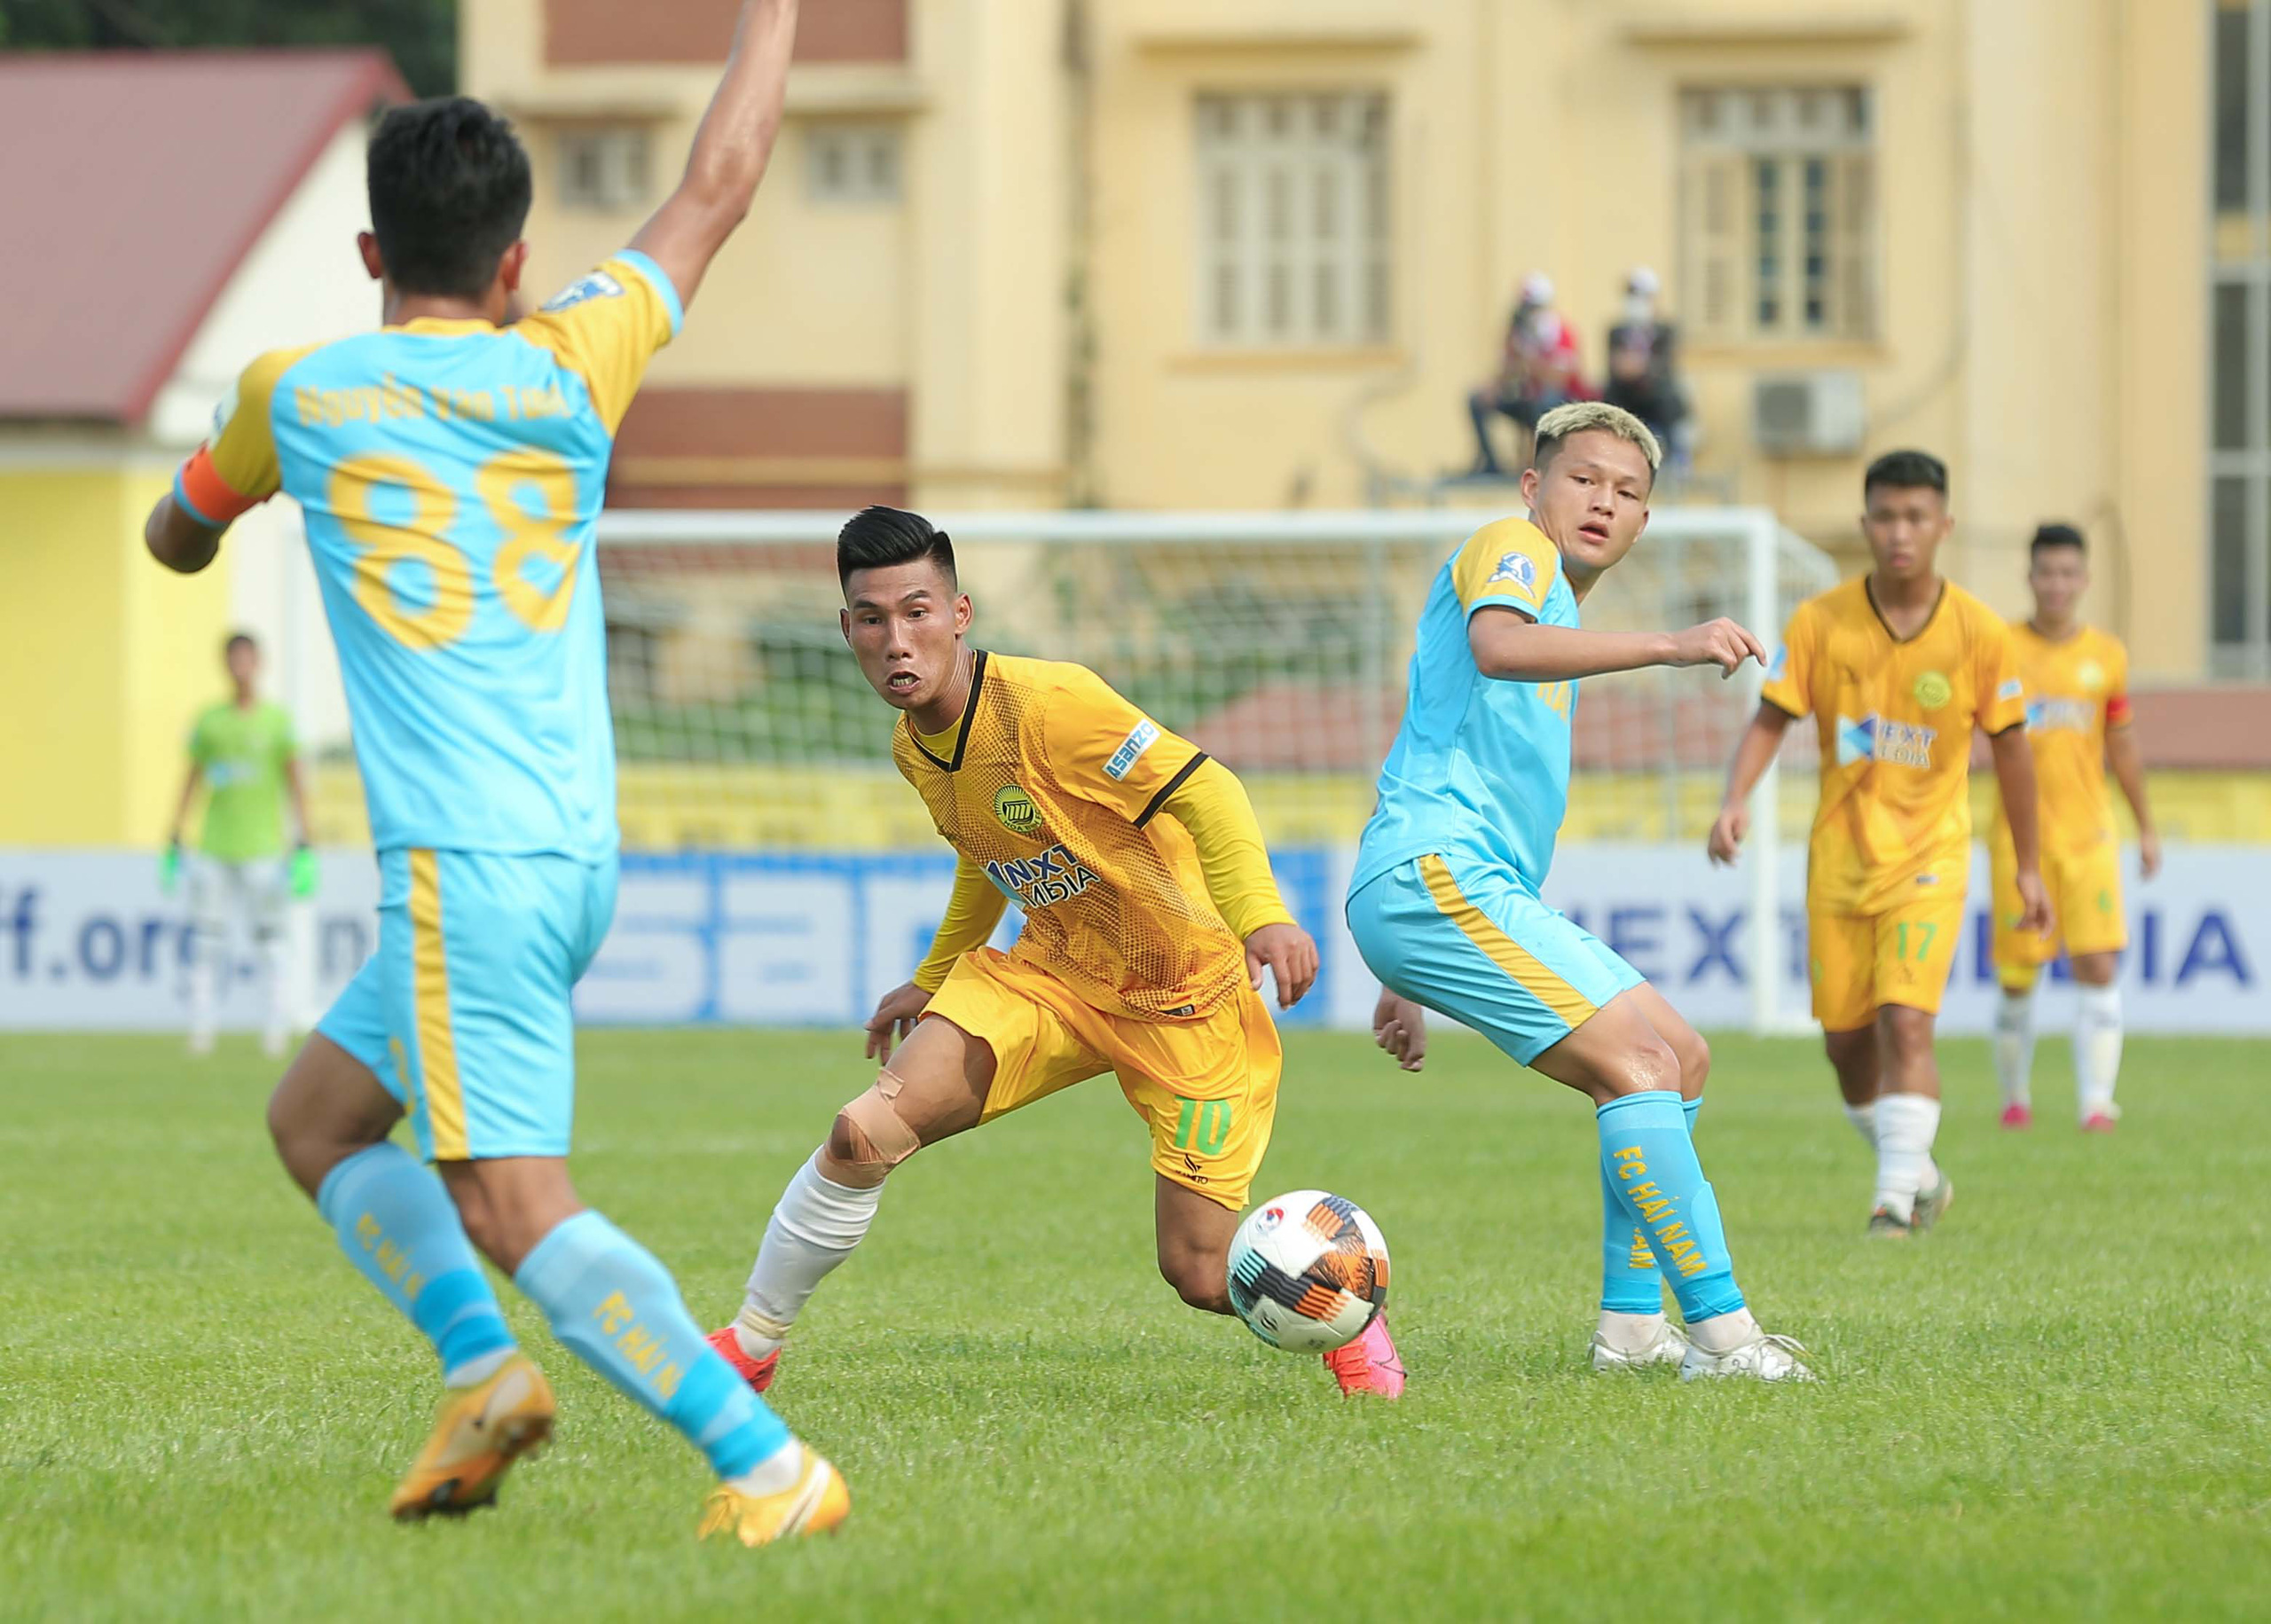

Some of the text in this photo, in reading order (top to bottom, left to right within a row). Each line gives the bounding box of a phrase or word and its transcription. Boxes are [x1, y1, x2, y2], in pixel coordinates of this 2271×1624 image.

[326, 446, 580, 652] 88
[1002, 843, 1077, 889] NXT
[1567, 904, 1811, 985] EXT
[1897, 921, 1938, 963] 17
[1174, 1094, 1232, 1156] 10
[1612, 1144, 1649, 1181] FC
[1654, 1220, 1709, 1278] NAM
[1629, 1227, 1656, 1270] AM
[593, 1289, 634, 1337] FC
